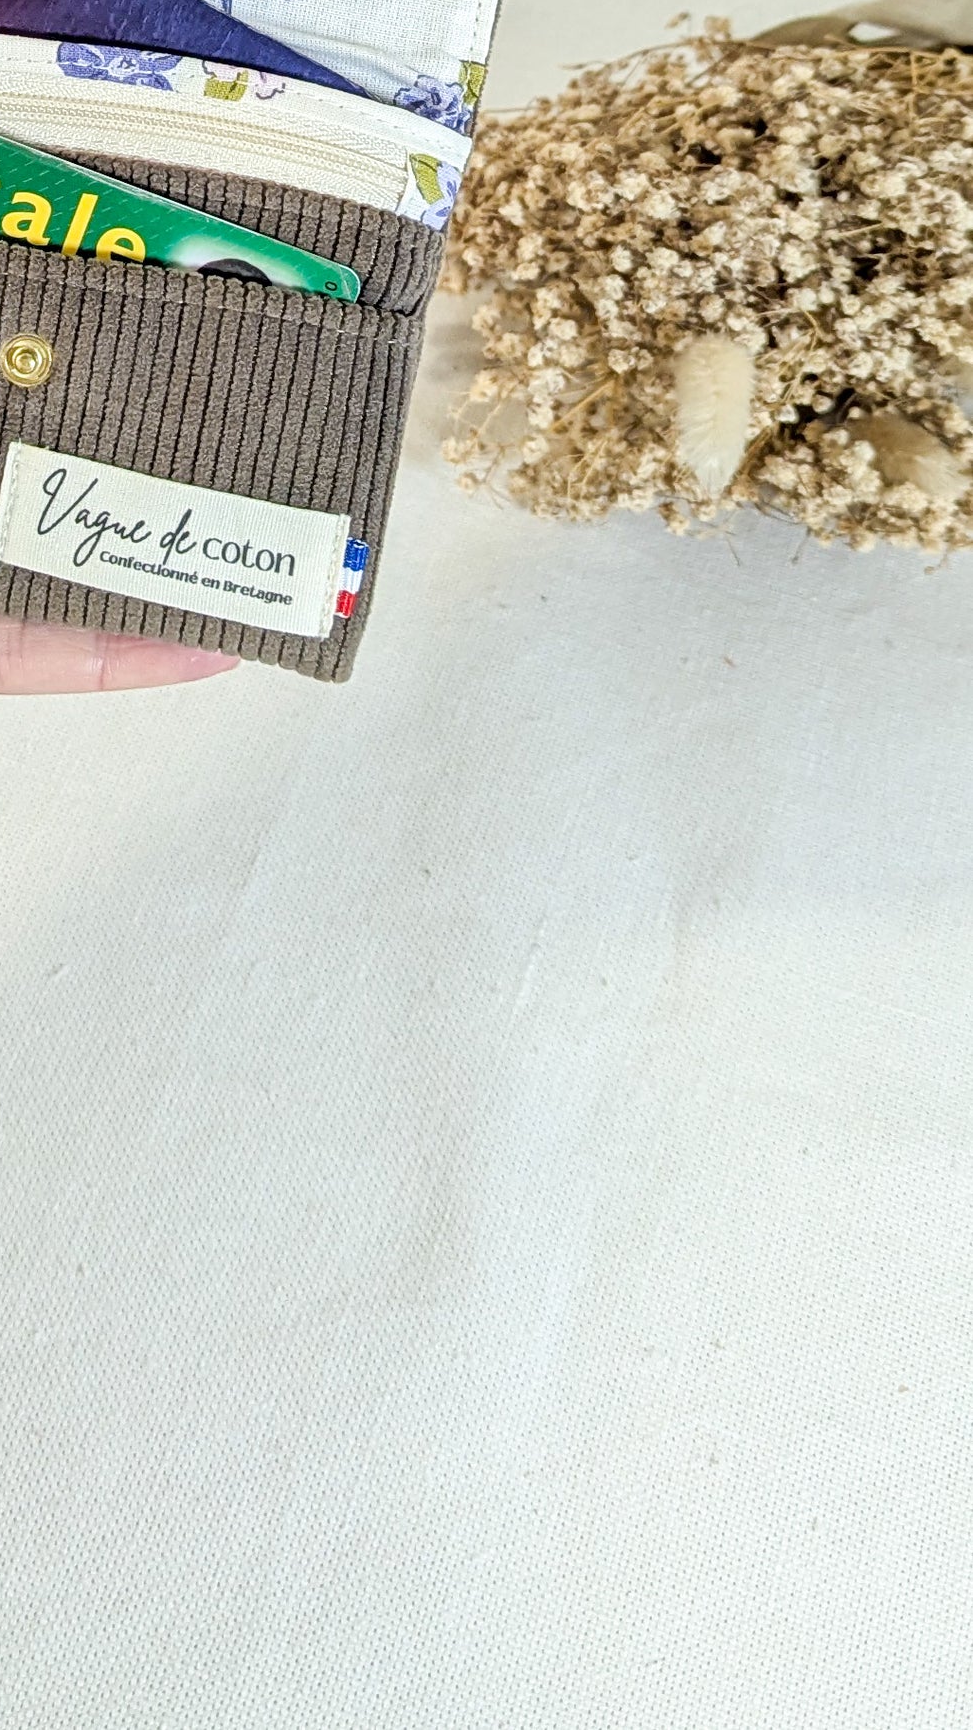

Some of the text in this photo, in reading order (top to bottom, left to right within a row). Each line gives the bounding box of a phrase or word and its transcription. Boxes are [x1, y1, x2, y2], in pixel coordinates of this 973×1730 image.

[37, 468, 295, 577] Vague de coton
[100, 551, 293, 605] Confectionné en Bretagne
